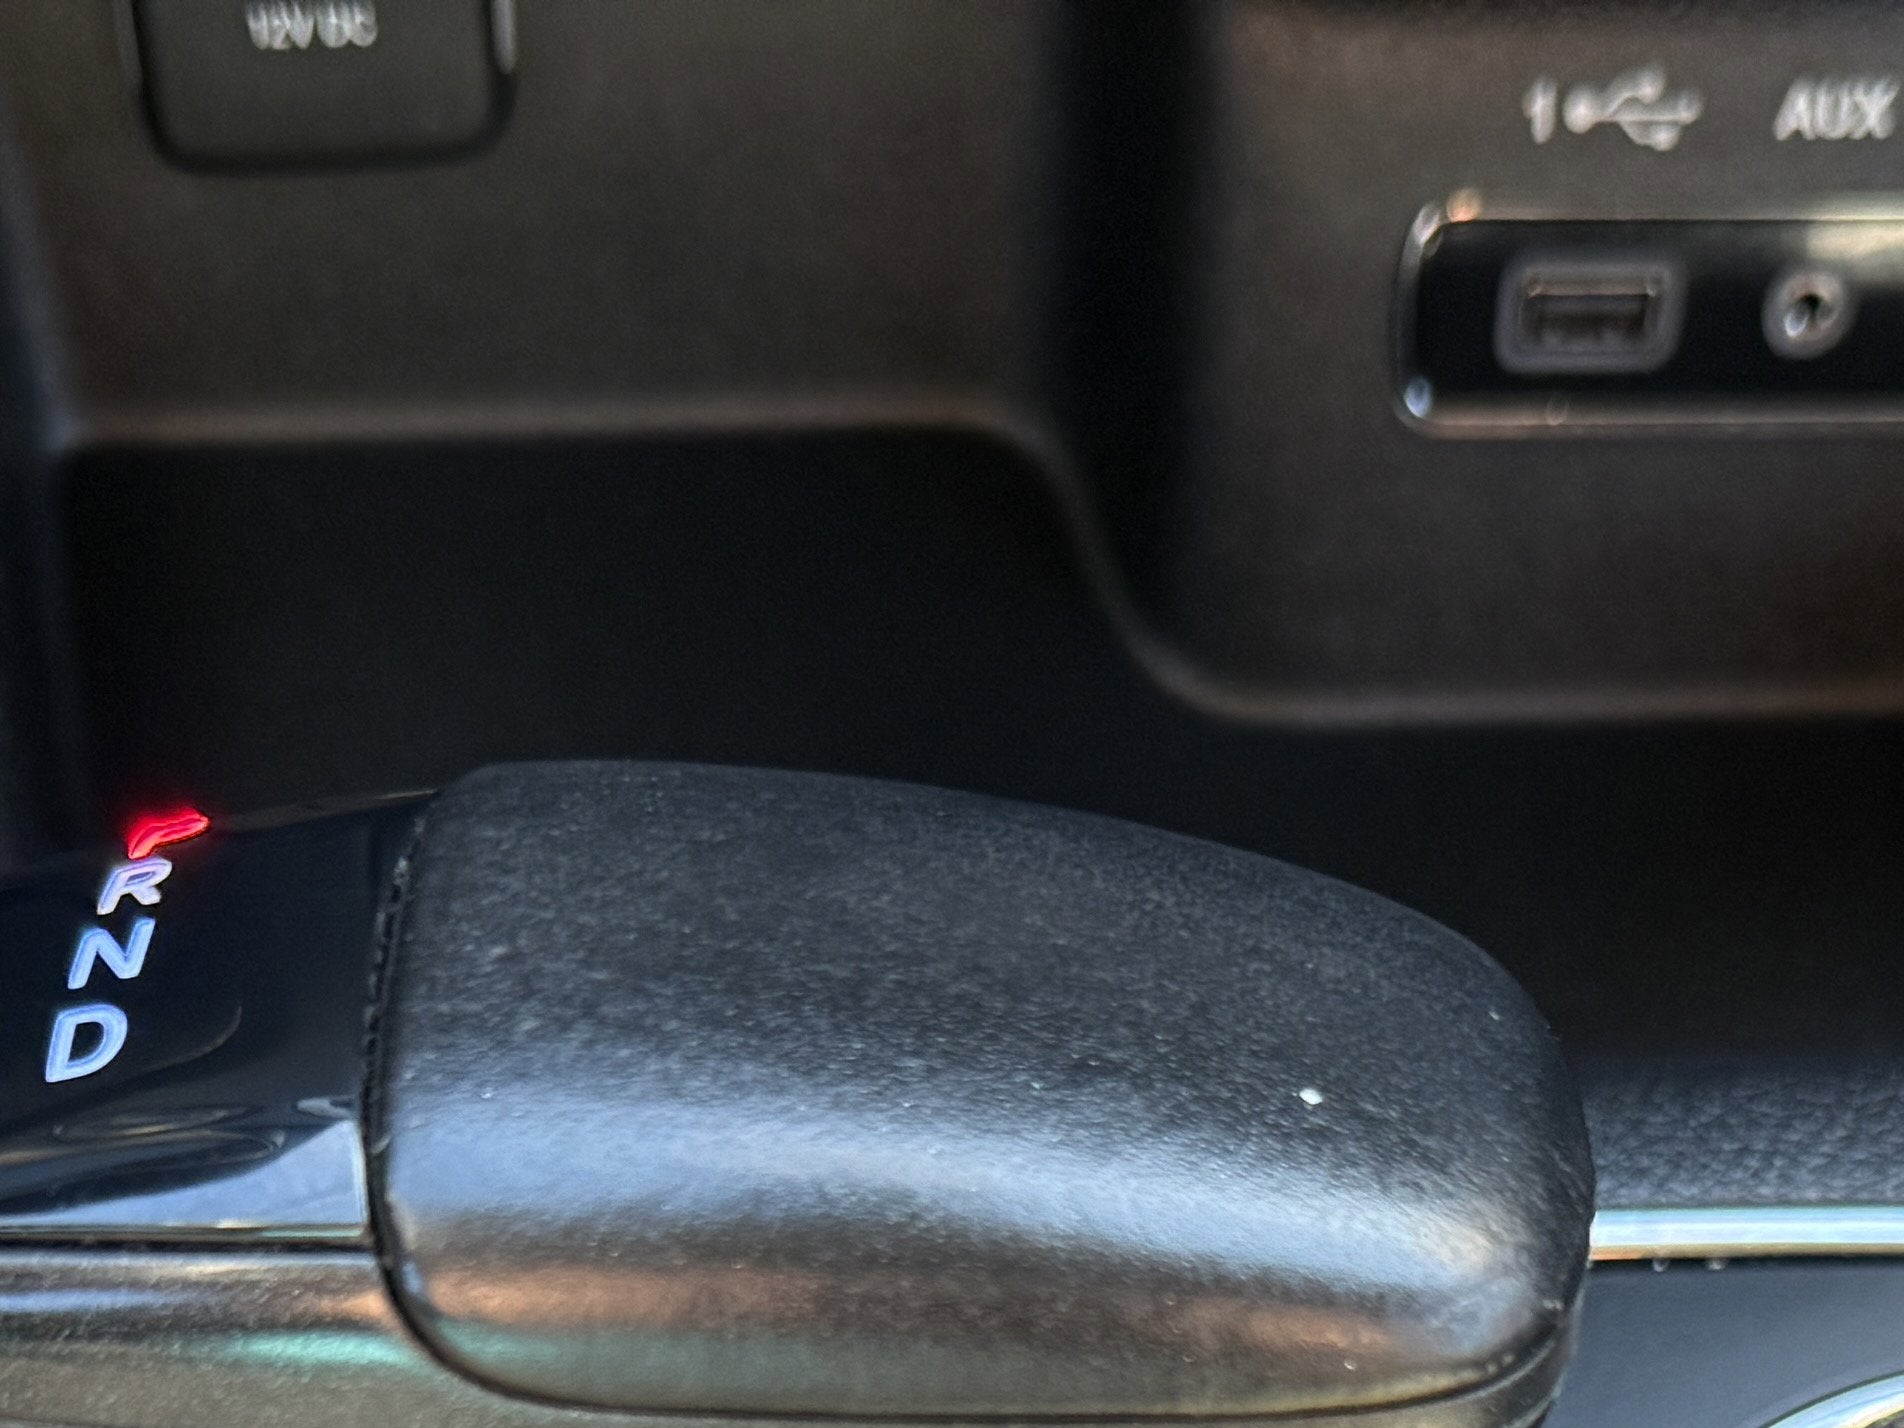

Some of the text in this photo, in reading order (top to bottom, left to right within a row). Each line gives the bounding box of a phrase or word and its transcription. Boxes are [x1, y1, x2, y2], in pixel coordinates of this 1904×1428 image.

[1773, 73, 1900, 142] AUX
[96, 855, 173, 915] R
[67, 916, 156, 990] N
[45, 1003, 129, 1083] D
